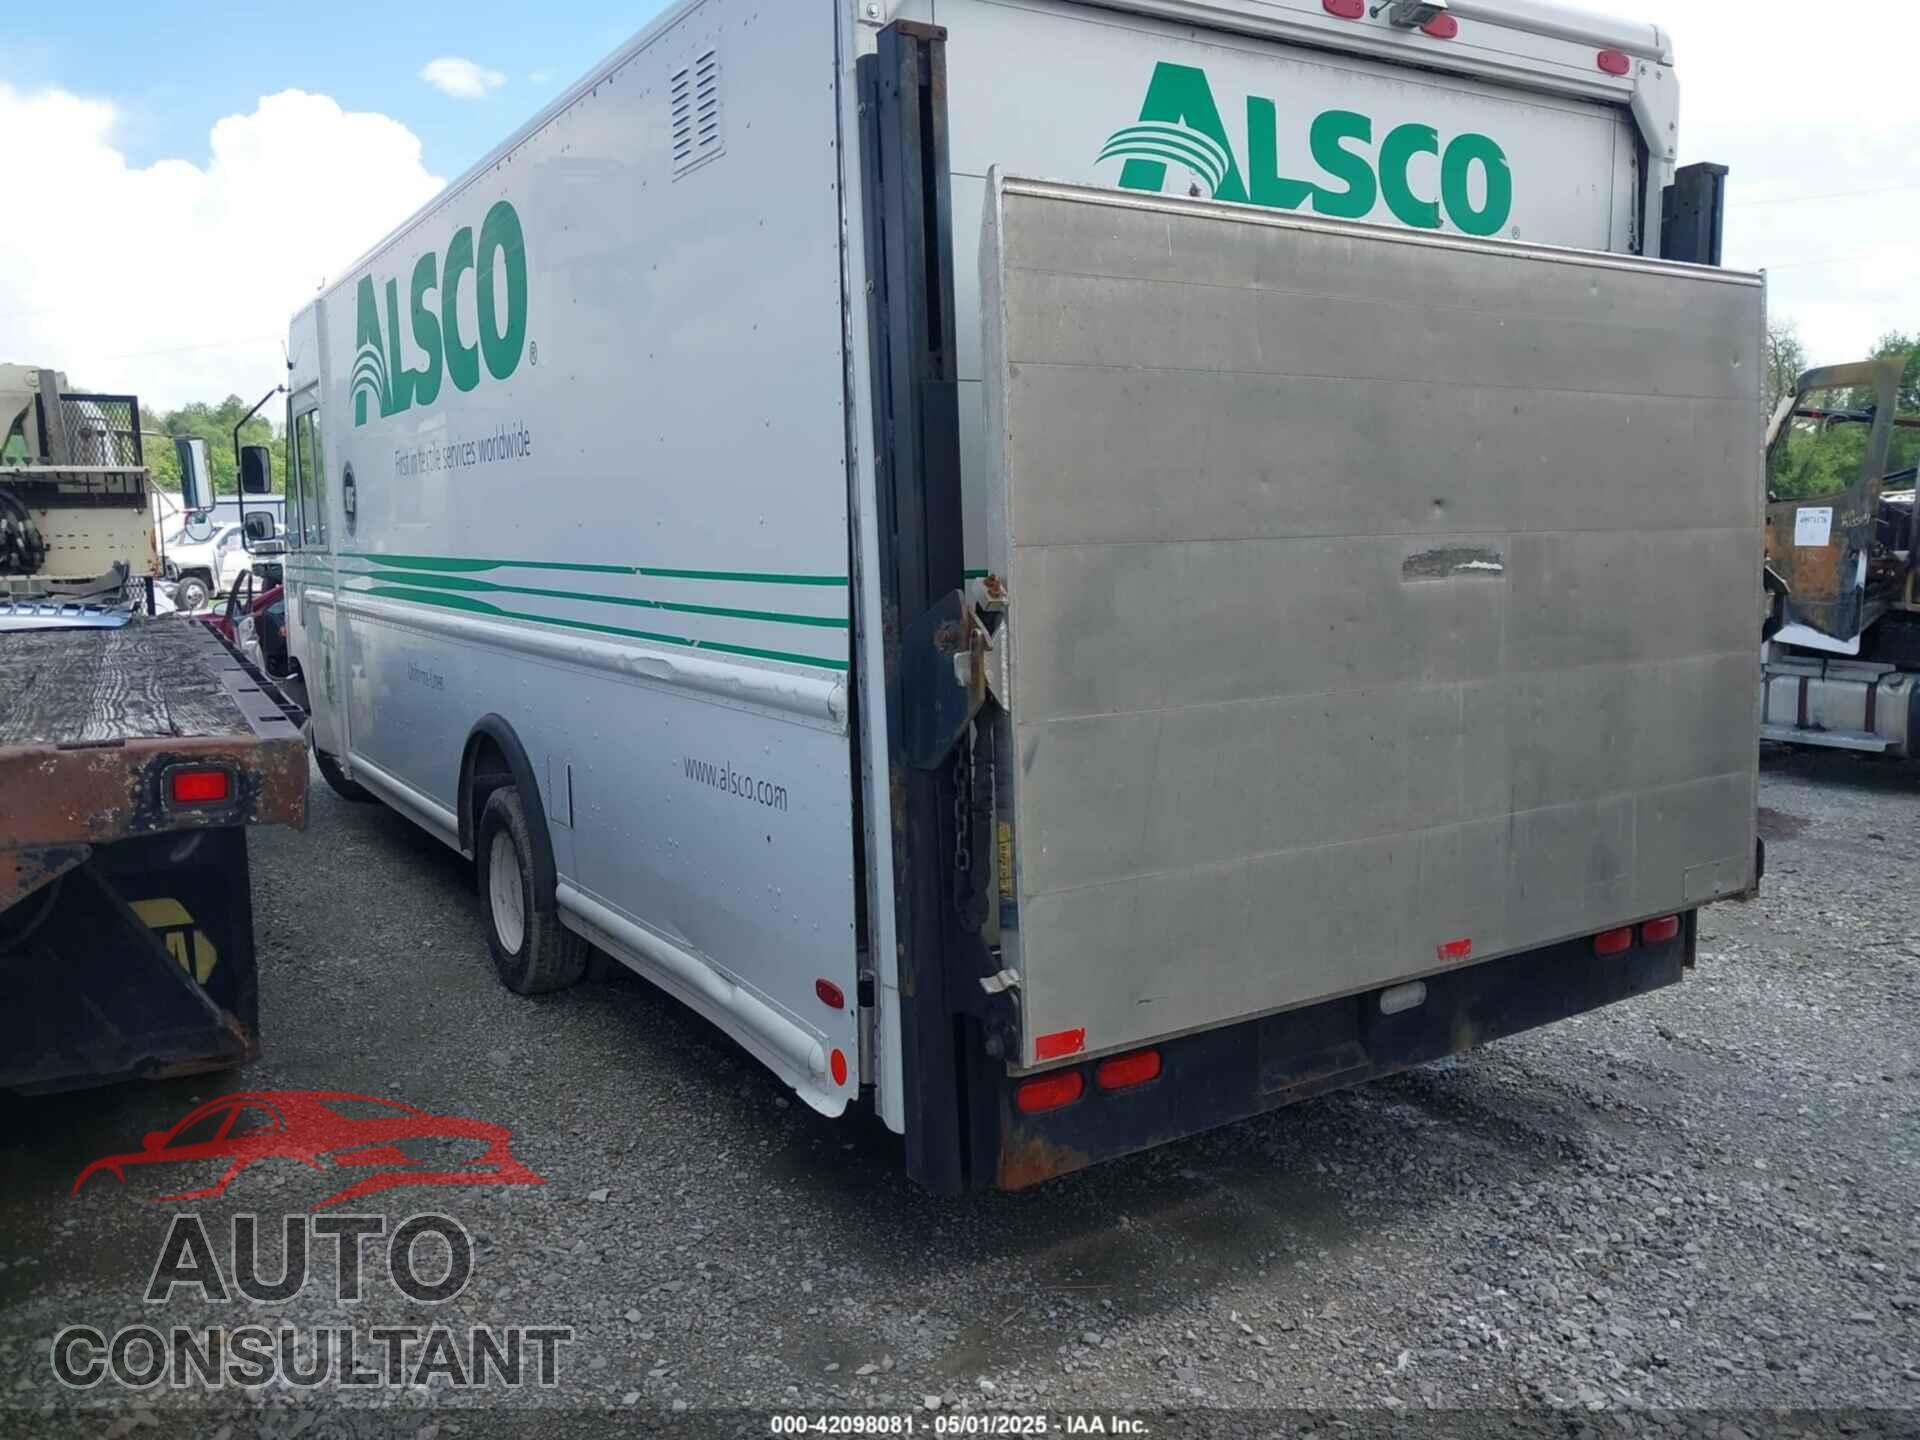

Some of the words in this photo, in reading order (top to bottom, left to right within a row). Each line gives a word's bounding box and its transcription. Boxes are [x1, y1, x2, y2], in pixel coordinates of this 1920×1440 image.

[1095, 61, 1512, 236] ALSCO
[350, 200, 527, 427] ALSCO
[443, 436, 475, 470] services
[478, 419, 530, 465] worldwide
[683, 757, 787, 812] www.alsco.com
